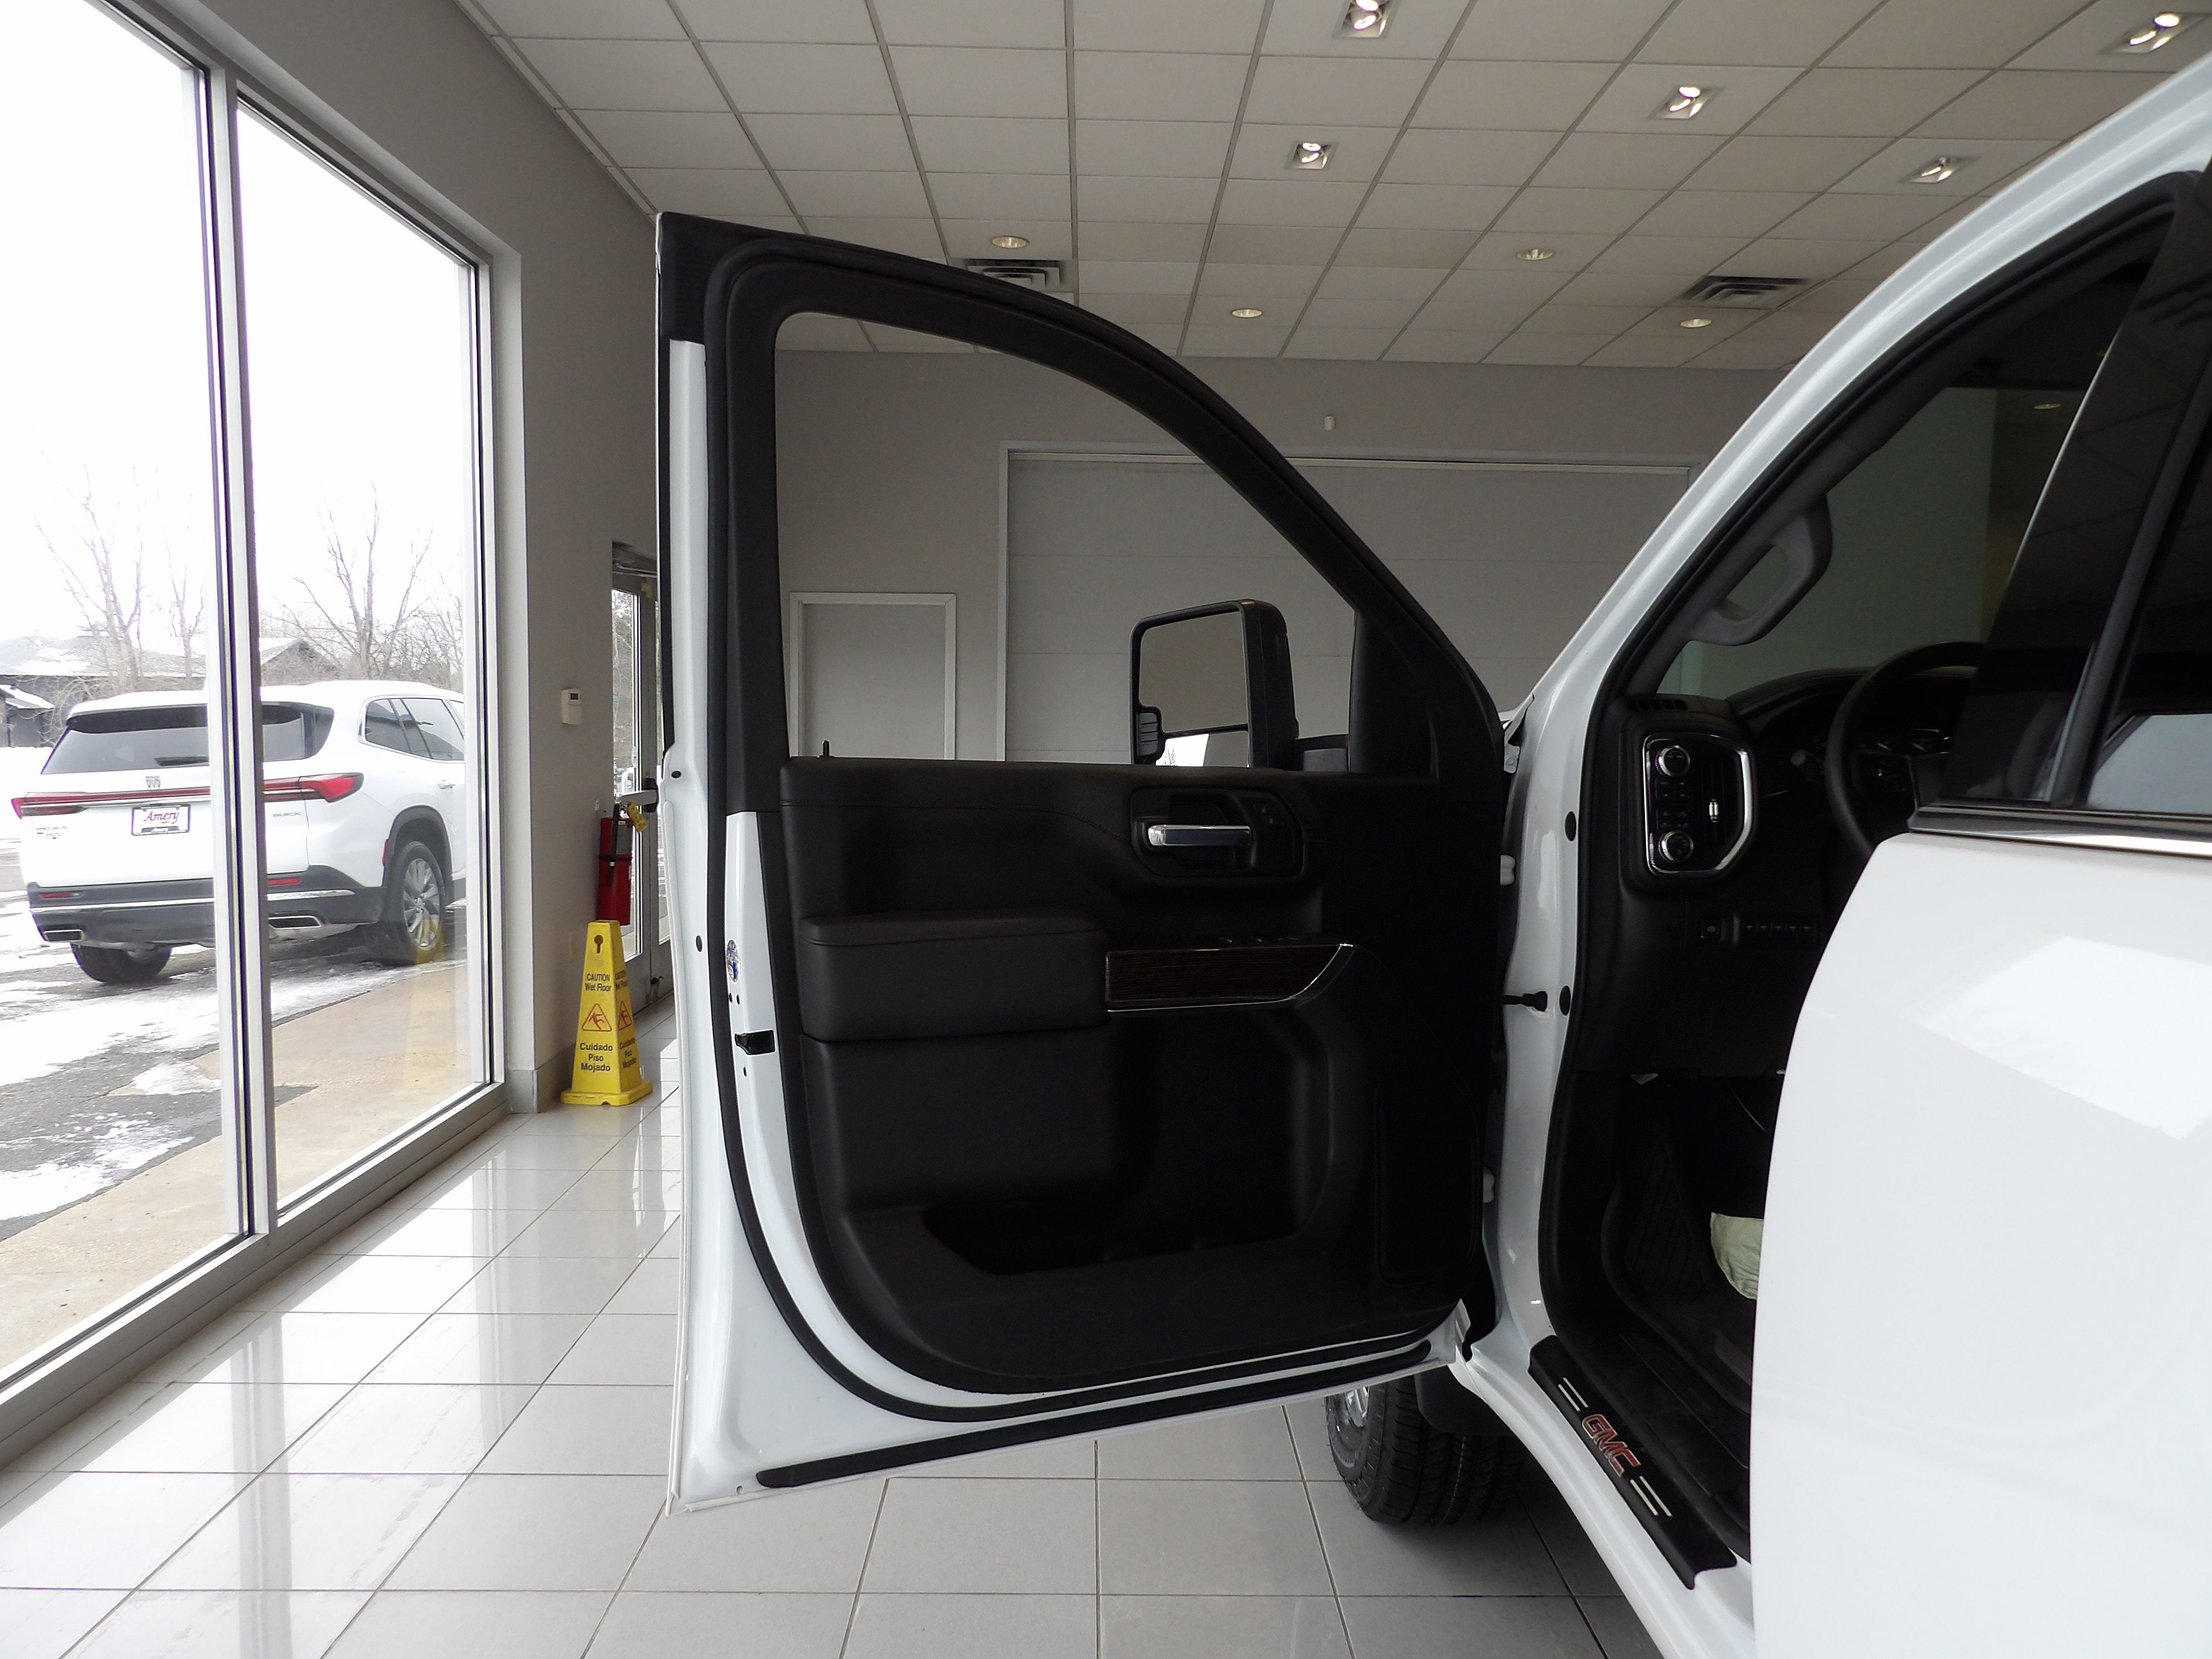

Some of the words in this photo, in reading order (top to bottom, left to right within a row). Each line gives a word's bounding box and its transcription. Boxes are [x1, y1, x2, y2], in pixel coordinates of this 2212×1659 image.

[144, 811, 180, 824] Amery
[587, 973, 610, 981] CAUTION
[585, 983, 596, 991] Wet
[597, 983, 612, 992] Floor
[580, 1041, 613, 1051] Cuidado
[588, 1053, 603, 1061] Piso
[581, 1062, 611, 1072] Mojado
[1582, 1414, 1641, 1478] GMC
